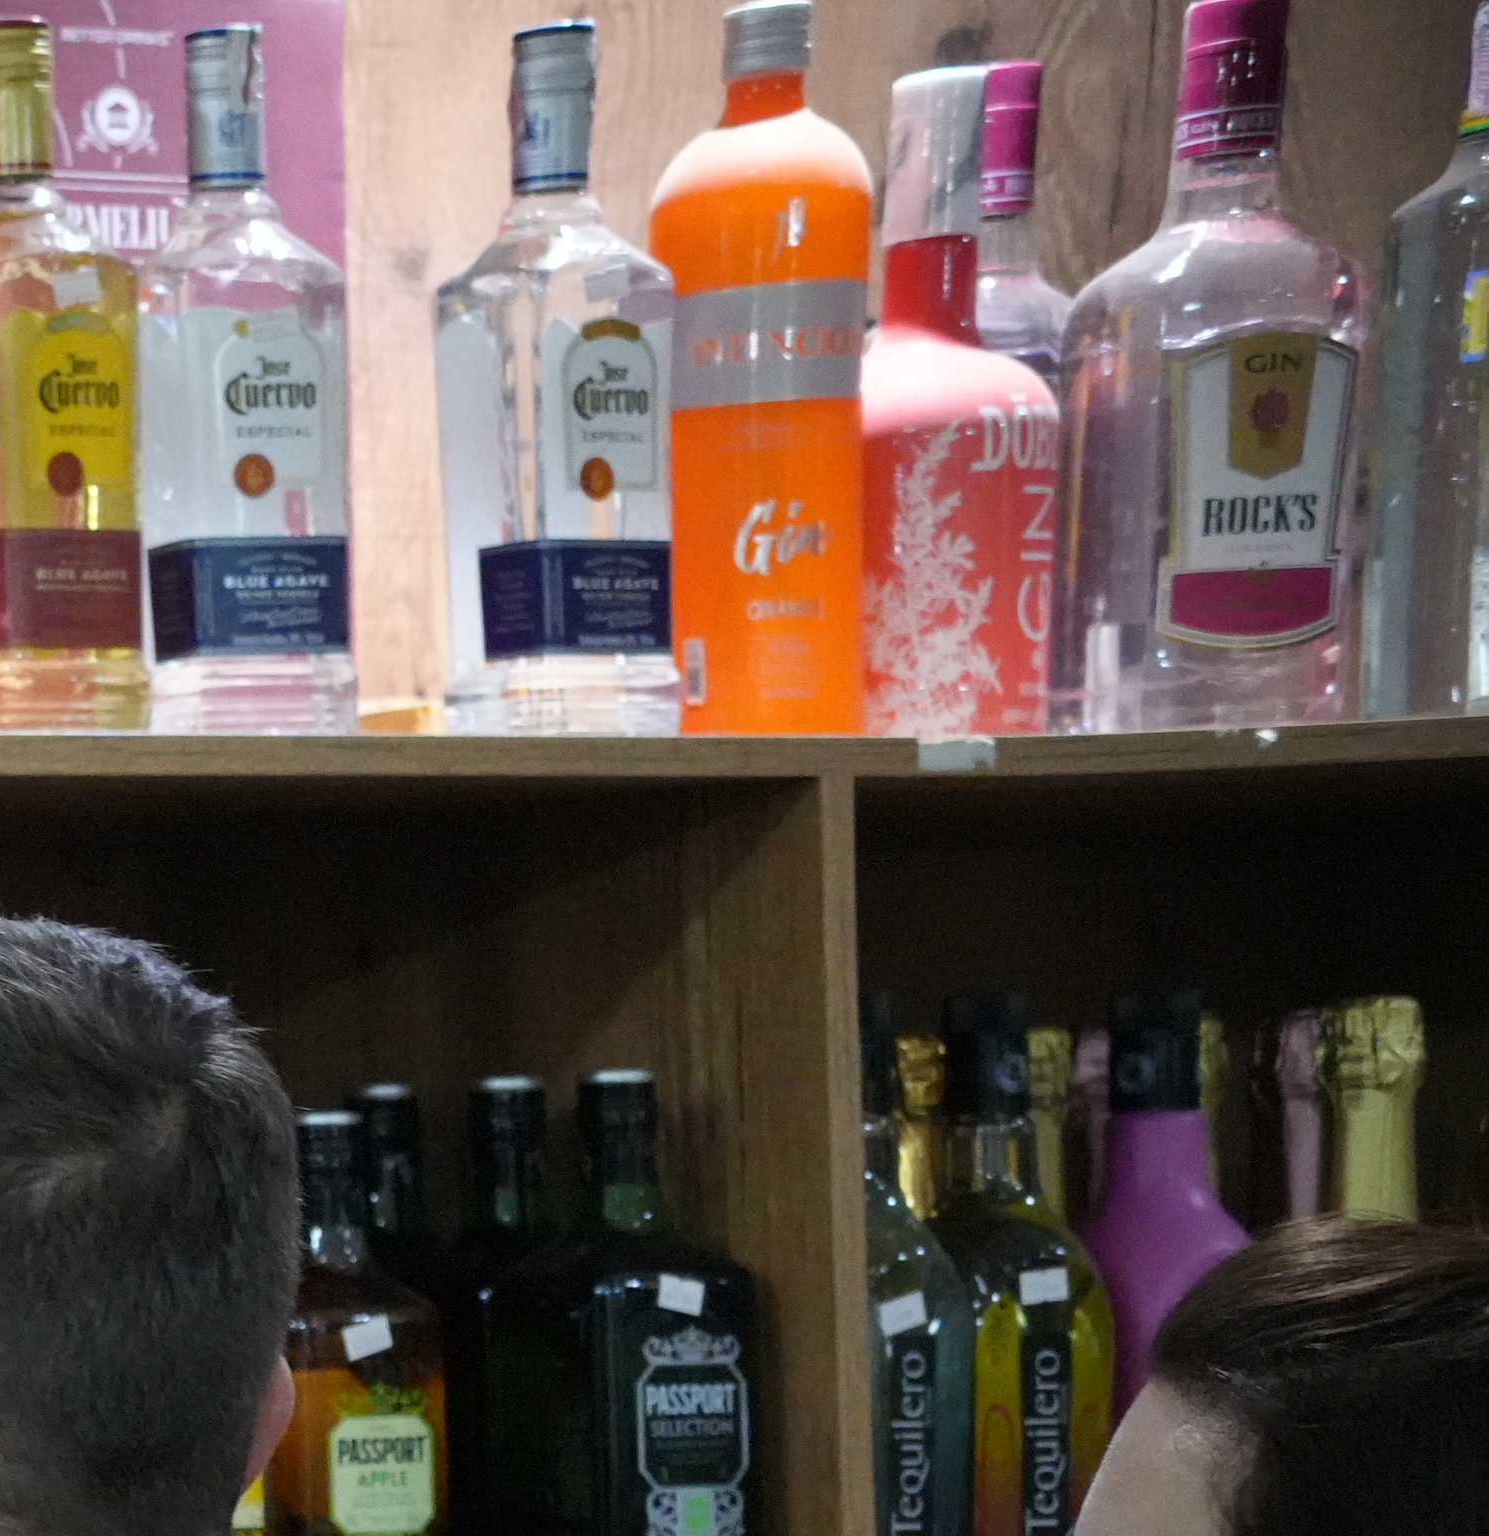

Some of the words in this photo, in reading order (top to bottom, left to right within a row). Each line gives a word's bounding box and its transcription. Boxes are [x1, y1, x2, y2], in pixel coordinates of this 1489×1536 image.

[1243, 352, 1303, 373] GIN
[38, 370, 120, 414] Cuervo
[224, 371, 317, 415] Cuervo
[573, 376, 649, 421] Cuervo
[734, 497, 829, 576] Gin
[1202, 494, 1318, 537] ROCK'S
[646, 1382, 737, 1416] PASSPORT
[338, 1436, 427, 1465] PASSPORT
[358, 1471, 408, 1487] APPLE
